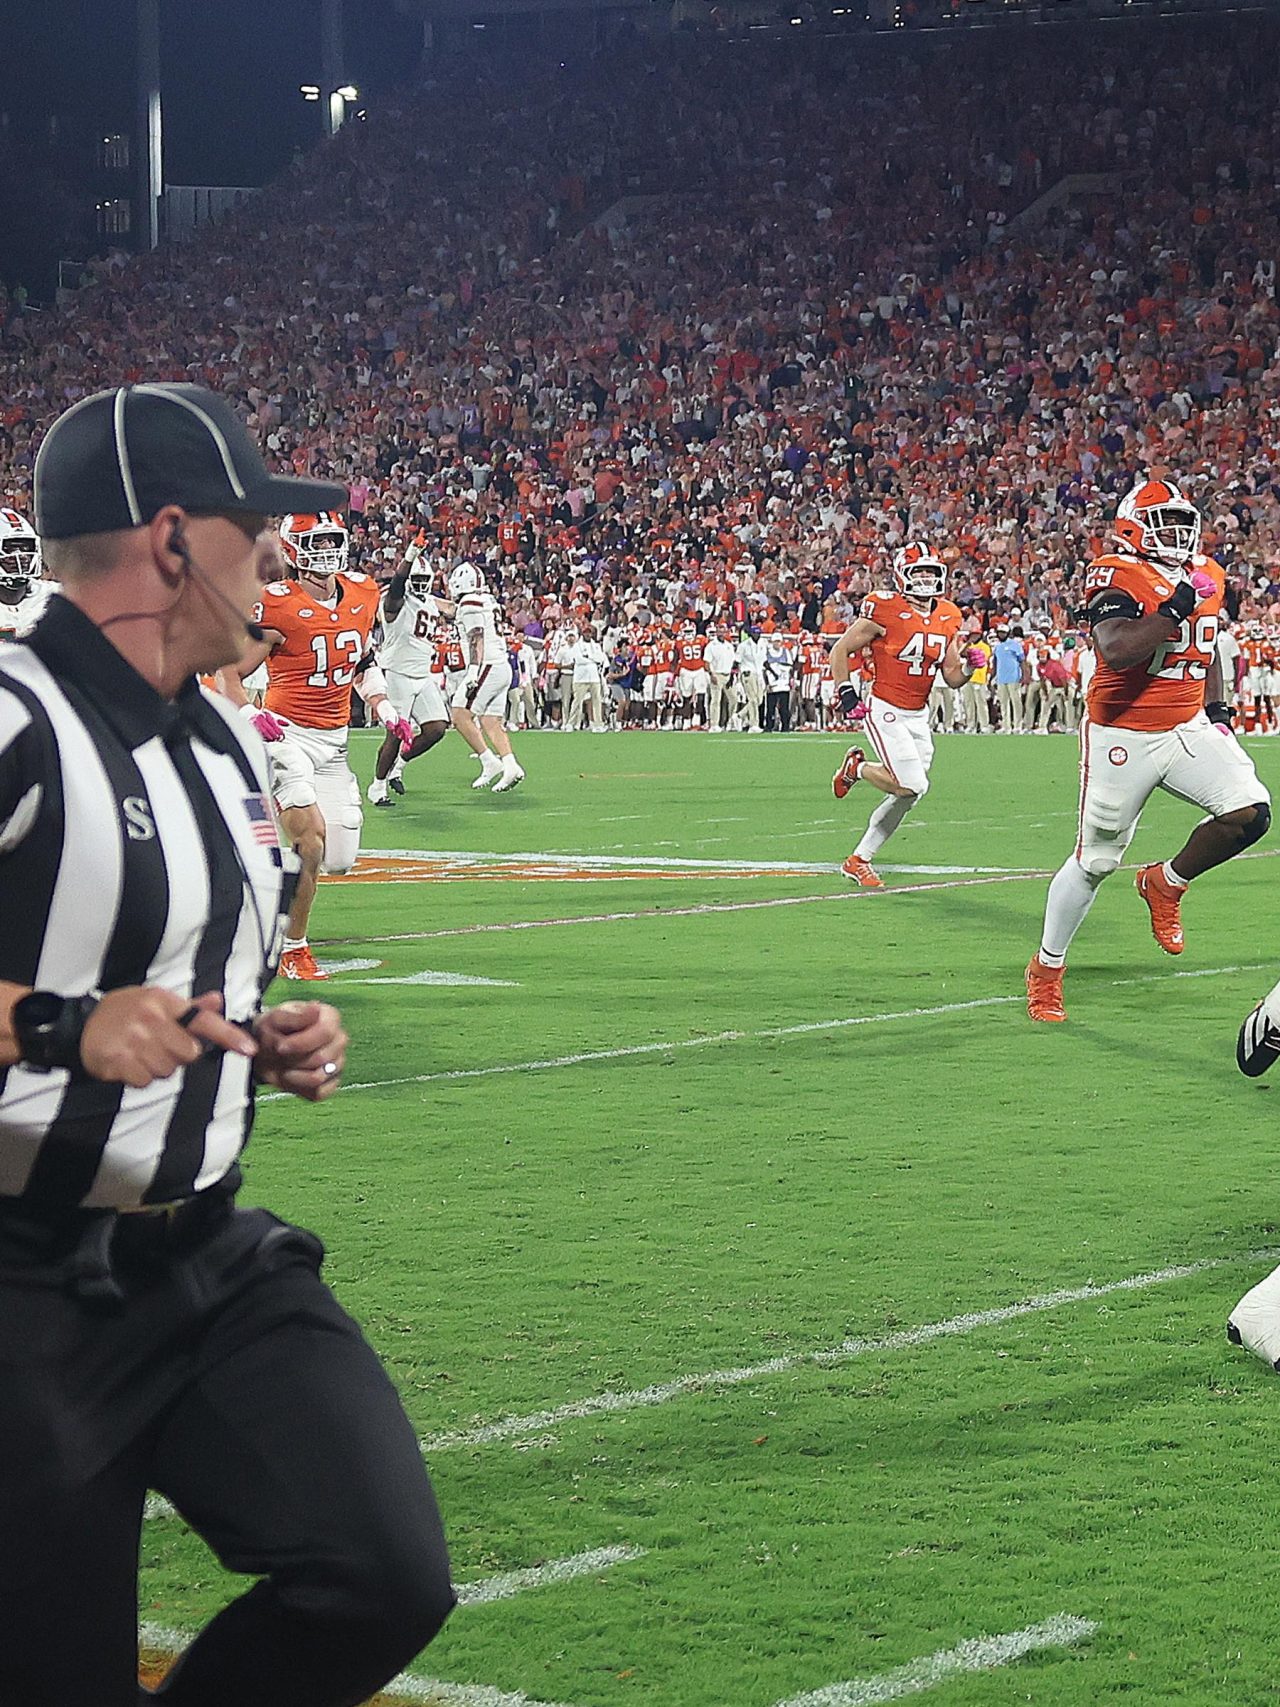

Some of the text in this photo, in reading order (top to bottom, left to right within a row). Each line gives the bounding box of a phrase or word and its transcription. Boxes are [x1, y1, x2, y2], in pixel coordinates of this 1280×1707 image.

[1086, 566, 1115, 588] 29
[860, 600, 875, 619] 47
[307, 629, 363, 688] 13
[683, 645, 701, 660] 95
[898, 632, 948, 676] 47
[1147, 615, 1219, 680] 29
[122, 796, 156, 841] S
